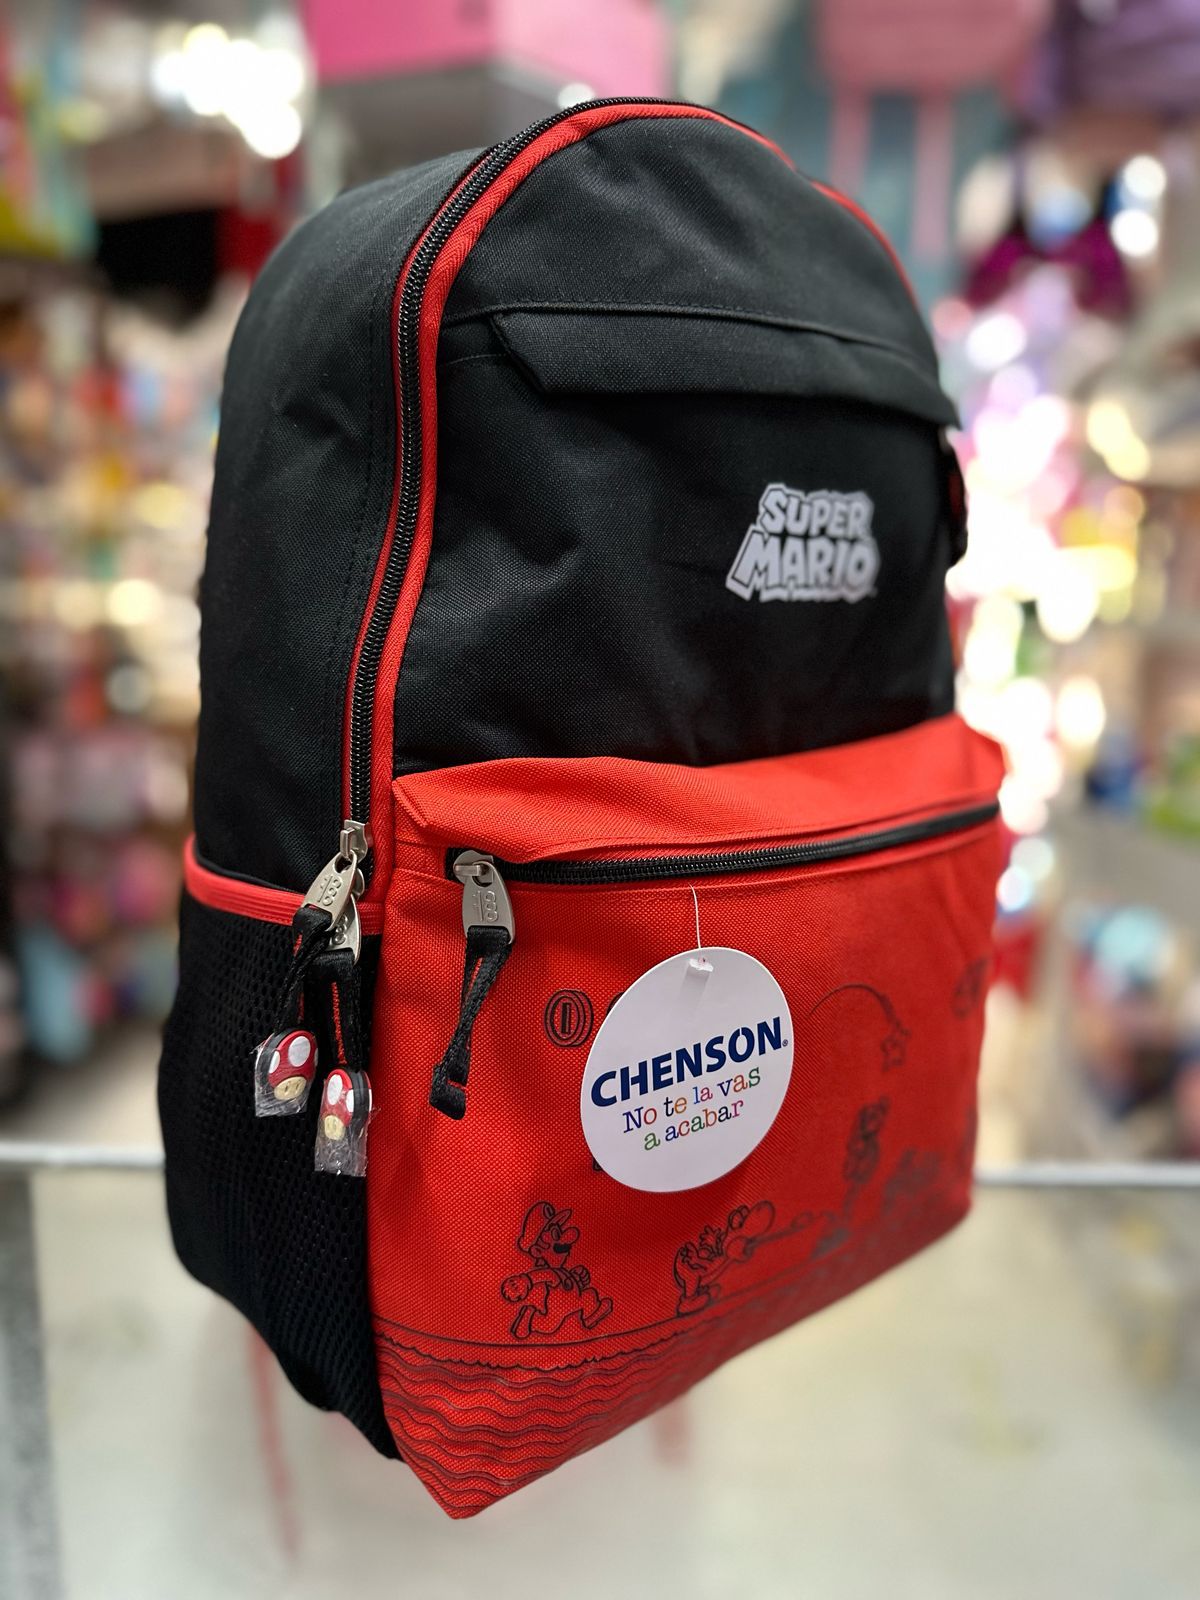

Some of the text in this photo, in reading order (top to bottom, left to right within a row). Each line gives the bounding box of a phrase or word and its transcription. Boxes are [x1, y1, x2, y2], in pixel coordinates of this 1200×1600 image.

[759, 485, 871, 539] SUPER
[729, 529, 878, 596] MARIO
[622, 1066, 761, 1134] No te la vas
[643, 1099, 744, 1151] a acabar
